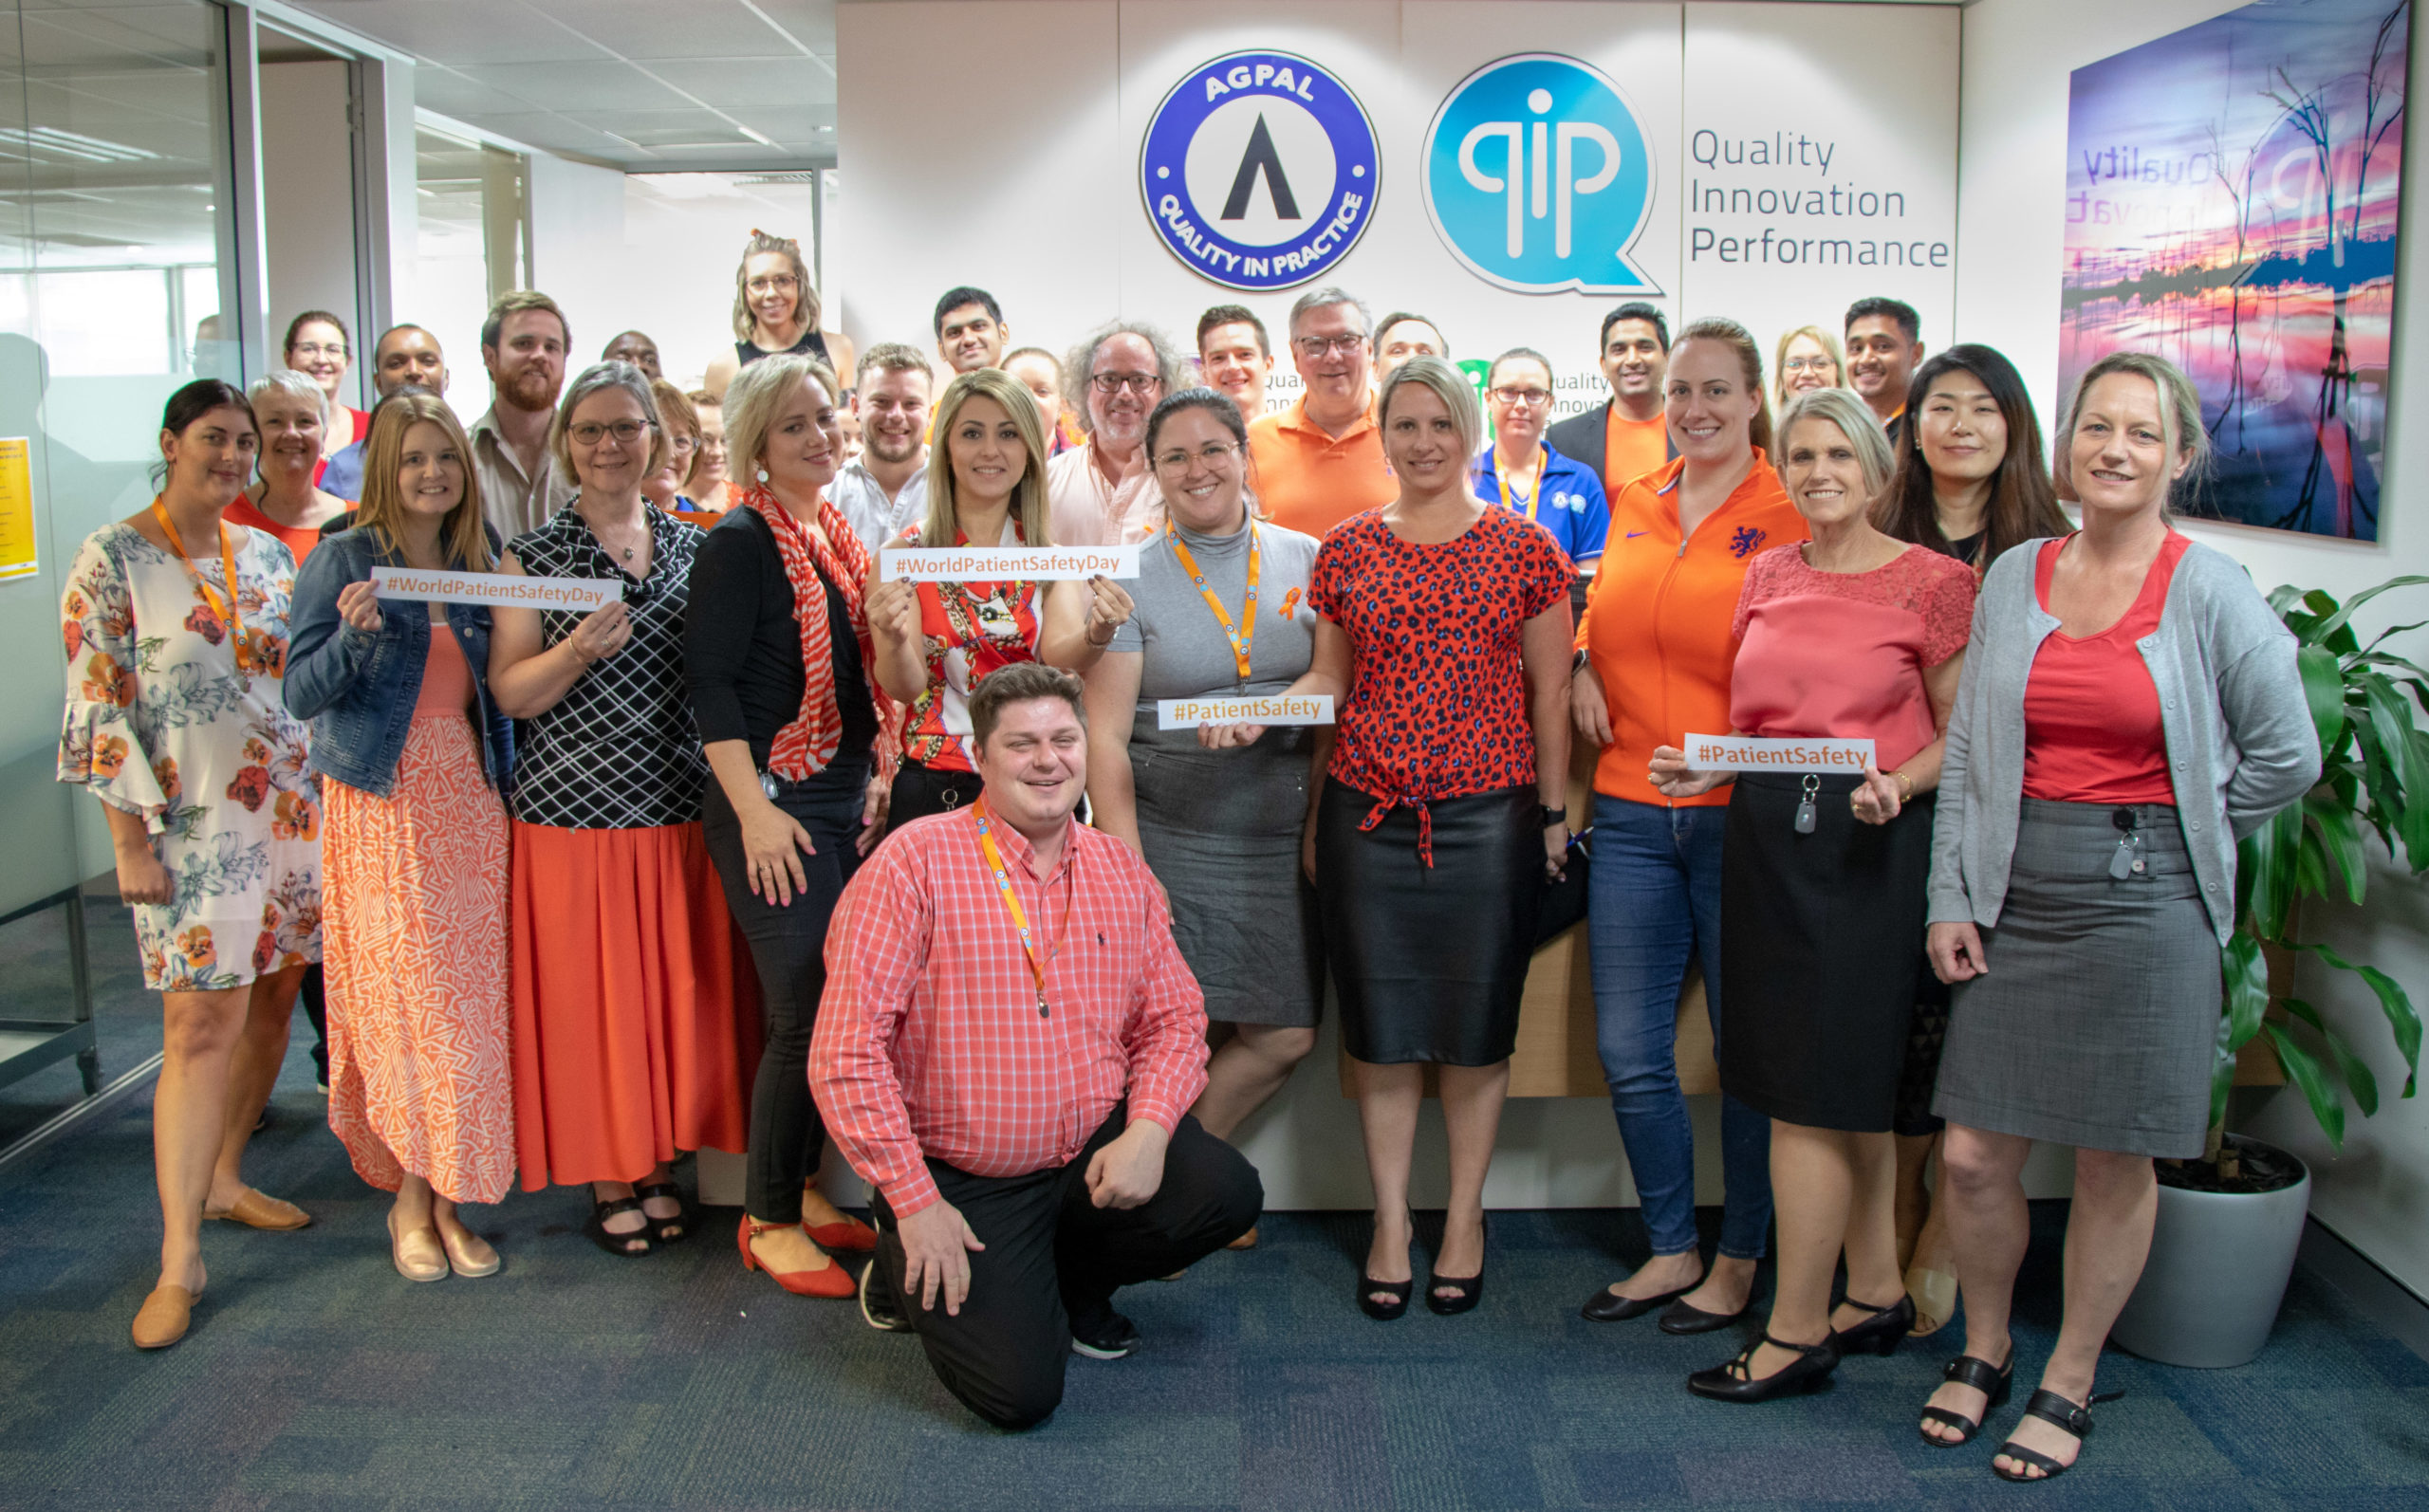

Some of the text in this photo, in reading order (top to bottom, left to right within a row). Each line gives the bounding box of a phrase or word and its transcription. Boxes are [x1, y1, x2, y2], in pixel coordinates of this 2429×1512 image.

[1205, 64, 1314, 102] AGPAL
[1692, 129, 1835, 176] Quality
[1692, 178, 1905, 217] Innovation
[1159, 191, 1363, 277] QUALITY IN PRACTICE
[1691, 227, 1949, 267] Performance
[1556, 372, 1610, 394] uality
[896, 553, 1121, 574] #WorldPatientSafetyDay
[386, 576, 604, 605] #WorldPatientSafetyDay
[1174, 697, 1322, 721] #PatientSafety
[1698, 745, 1868, 769] #PatientSafety
